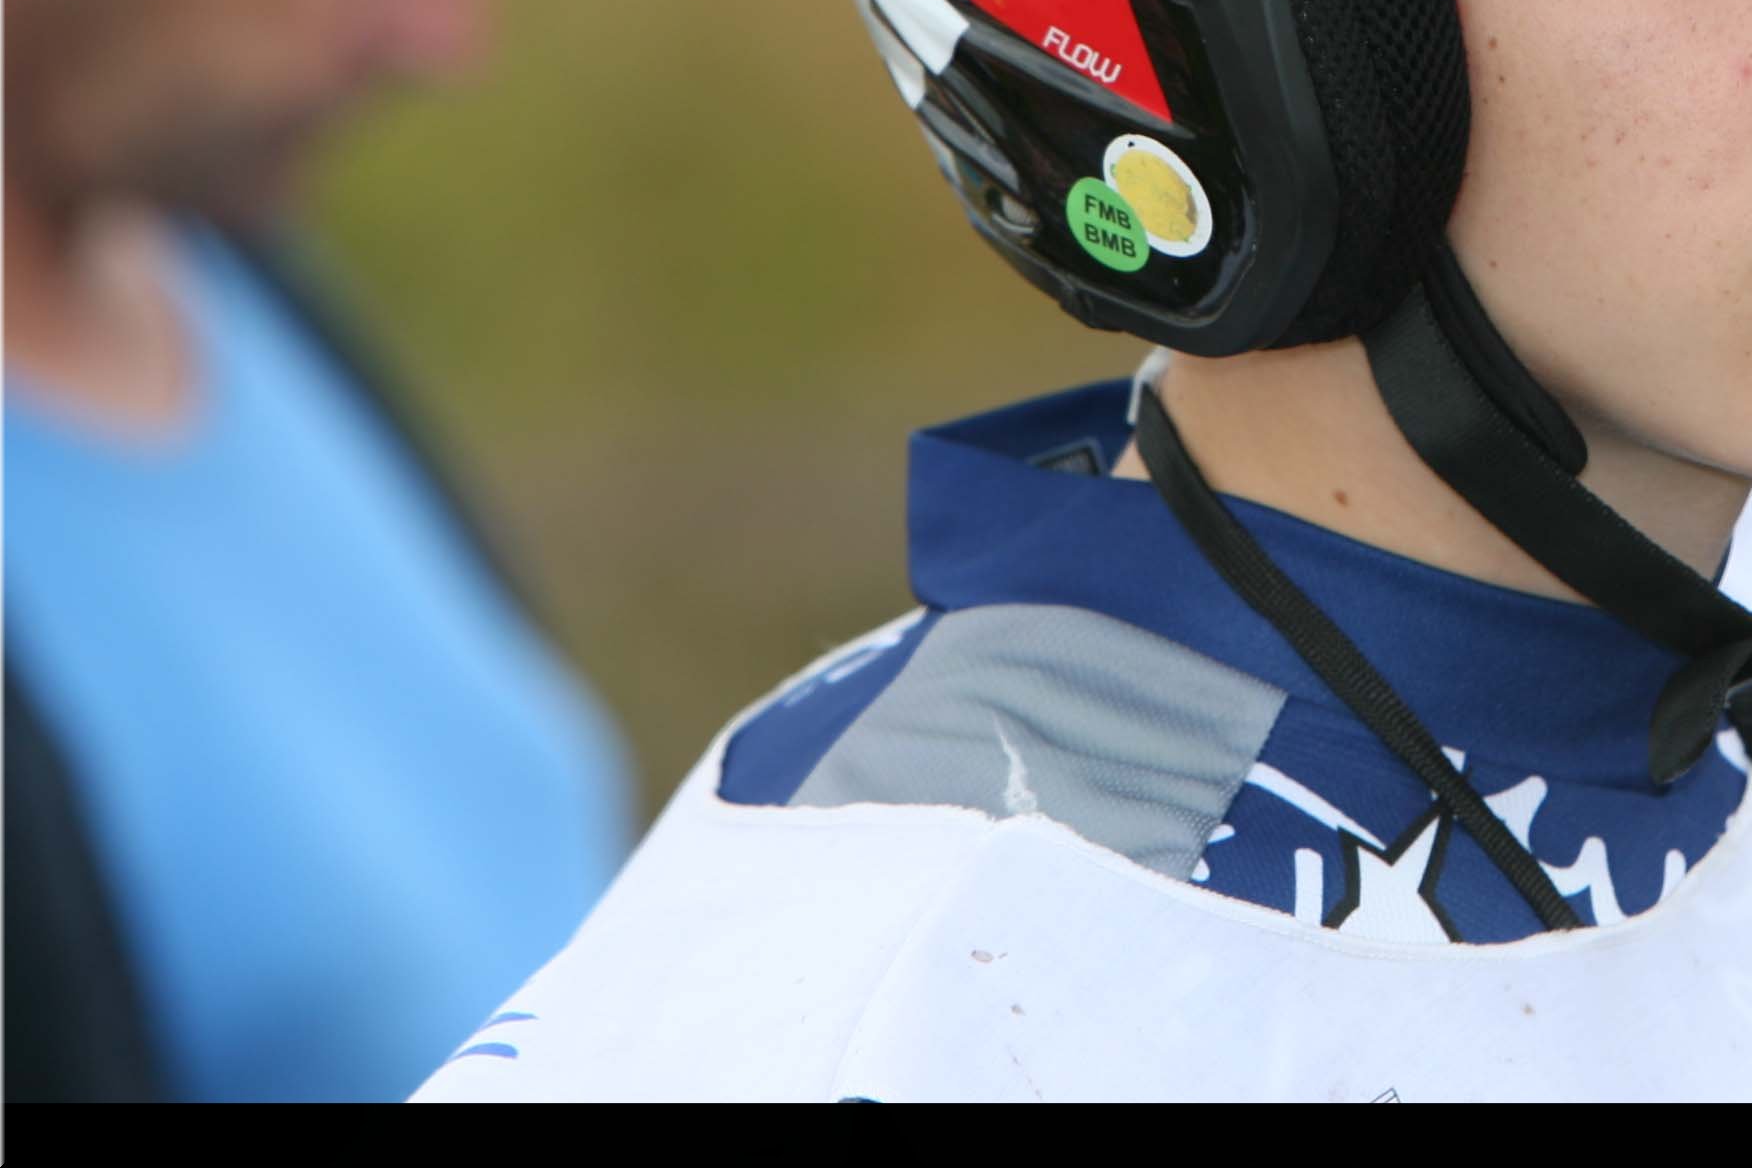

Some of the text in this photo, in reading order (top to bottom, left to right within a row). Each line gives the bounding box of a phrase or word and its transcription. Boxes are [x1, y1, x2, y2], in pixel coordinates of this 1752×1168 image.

[1043, 26, 1122, 83] FLOW
[1083, 193, 1132, 230] FMB
[1083, 223, 1137, 258] BMB
